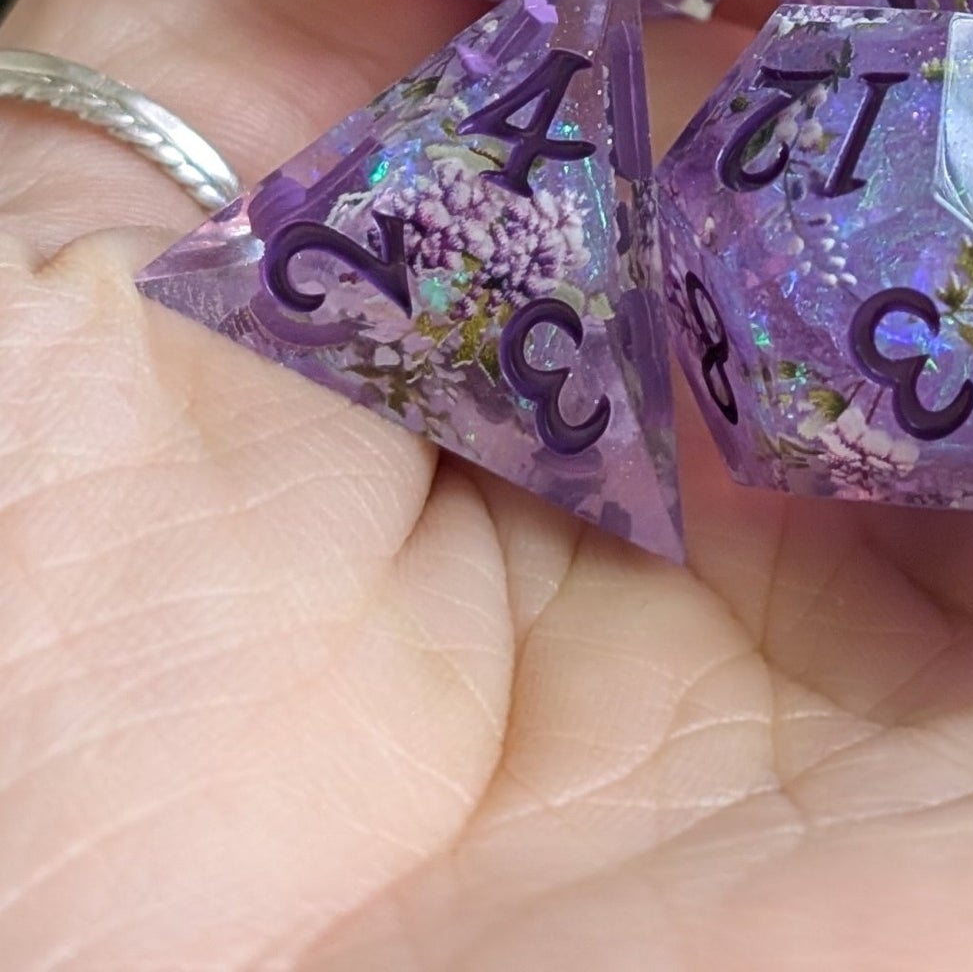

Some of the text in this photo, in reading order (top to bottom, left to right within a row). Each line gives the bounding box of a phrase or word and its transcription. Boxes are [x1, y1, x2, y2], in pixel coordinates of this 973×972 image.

[456, 46, 597, 198] 4
[713, 63, 912, 199] 12
[260, 209, 413, 320] 2
[499, 296, 611, 456] 3
[684, 269, 740, 427] 8
